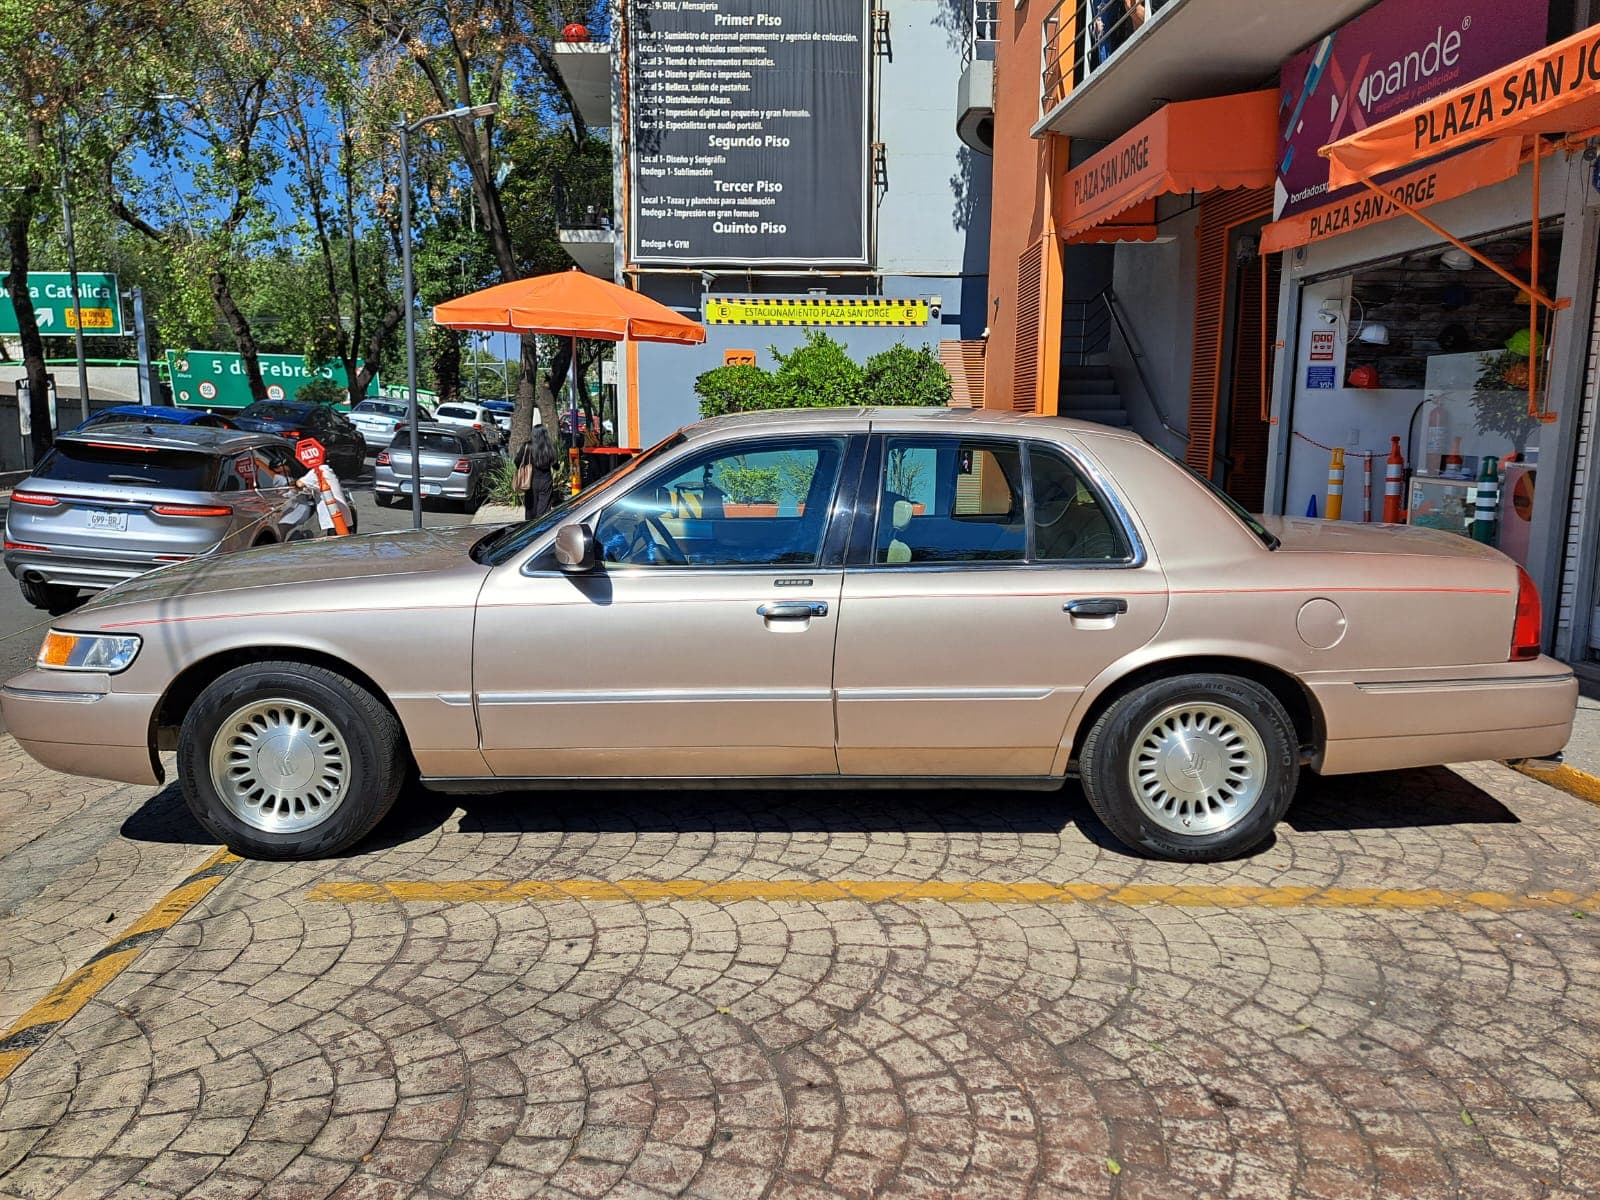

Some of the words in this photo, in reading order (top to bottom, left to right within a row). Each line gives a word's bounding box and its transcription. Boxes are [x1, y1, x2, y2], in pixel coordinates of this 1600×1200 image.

[662, 2, 677, 10] DHL
[714, 14, 754, 26] Primer
[757, 14, 782, 26] Piso
[664, 31, 700, 40] Suministro
[701, 32, 709, 40] de
[710, 32, 739, 42] personal
[740, 32, 780, 42] permanente
[780, 34, 785, 42] y
[785, 32, 812, 42] agencia
[812, 32, 822, 41] de
[664, 44, 684, 53] Venta
[685, 44, 694, 53] de
[664, 57, 687, 66] Tienda
[688, 57, 697, 66] de
[712, 71, 718, 79] e
[710, 83, 719, 91] de
[1414, 86, 1493, 150] PLAZA
[1501, 55, 1565, 117] SAN
[760, 110, 765, 120] y
[765, 110, 781, 120] gran
[717, 121, 736, 129] audio
[708, 135, 762, 149] Segundo
[764, 135, 790, 147] Piso
[640, 155, 658, 164] Local
[665, 155, 688, 164] Diseño
[689, 157, 694, 166] y
[640, 167, 667, 178] Bodega
[673, 167, 714, 176] Sublimación
[1074, 168, 1099, 208] PLAZA
[1100, 155, 1118, 192] SAN
[1118, 136, 1149, 183] JORGE
[713, 180, 755, 192] Tercer
[756, 180, 783, 192] Piso
[640, 196, 659, 204] Local
[685, 198, 691, 206] y
[690, 197, 721, 206] planchas
[720, 198, 737, 206] para
[1310, 205, 1350, 238] PLAZA
[1353, 194, 1384, 224] SAN
[1384, 174, 1437, 215] JORGE
[640, 208, 667, 219] Bodega
[674, 208, 707, 219] Impresión
[716, 210, 733, 219] gran
[733, 209, 760, 218] formato
[712, 221, 759, 235] Quinto
[760, 222, 787, 235] Piso
[640, 240, 667, 250] Bodega
[674, 240, 690, 249] GYM
[45, 283, 111, 299] Catlica
[720, 308, 728, 316] E
[744, 308, 819, 318] ESTACIONAMIENTO
[821, 309, 846, 318] PLAZA
[848, 309, 864, 318] SAN
[865, 309, 889, 319] JORGE
[906, 309, 913, 318] E
[212, 360, 223, 375] 5
[301, 448, 319, 461] ALTO
